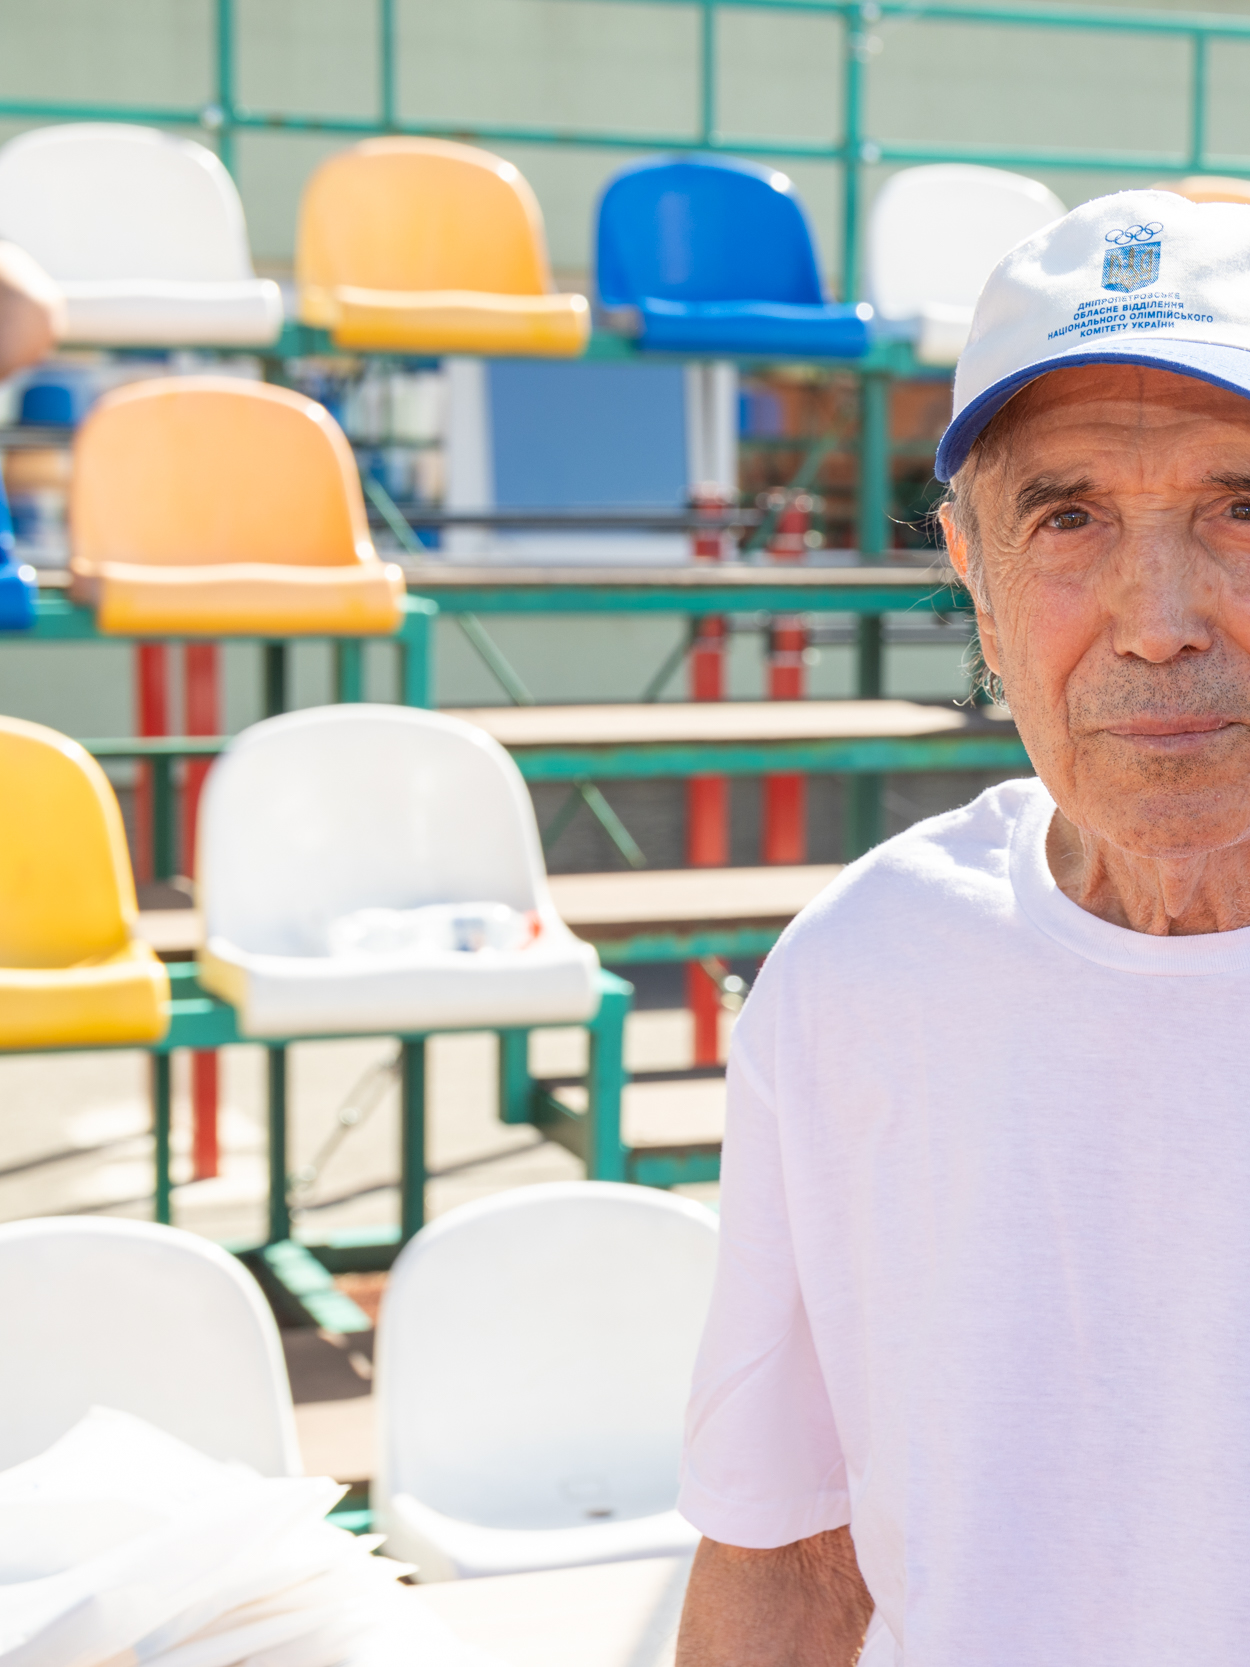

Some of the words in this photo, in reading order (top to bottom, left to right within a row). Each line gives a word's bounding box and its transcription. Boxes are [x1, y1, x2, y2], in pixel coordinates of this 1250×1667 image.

[1073, 306, 1119, 321] ОБЛАСНЕ
[1122, 301, 1184, 312] ВІДДІЛЕННЯ
[1077, 292, 1181, 311] ДНІПРОПЕТРОВСЬКЕ
[1047, 314, 1126, 340] НАЦІОНАЛЬНОГО
[1129, 310, 1214, 323] ОЛІМПІЙСЬКОГО
[1079, 323, 1129, 338] КОМІТЕТУ
[1131, 319, 1175, 330] УКРАЇНИ
